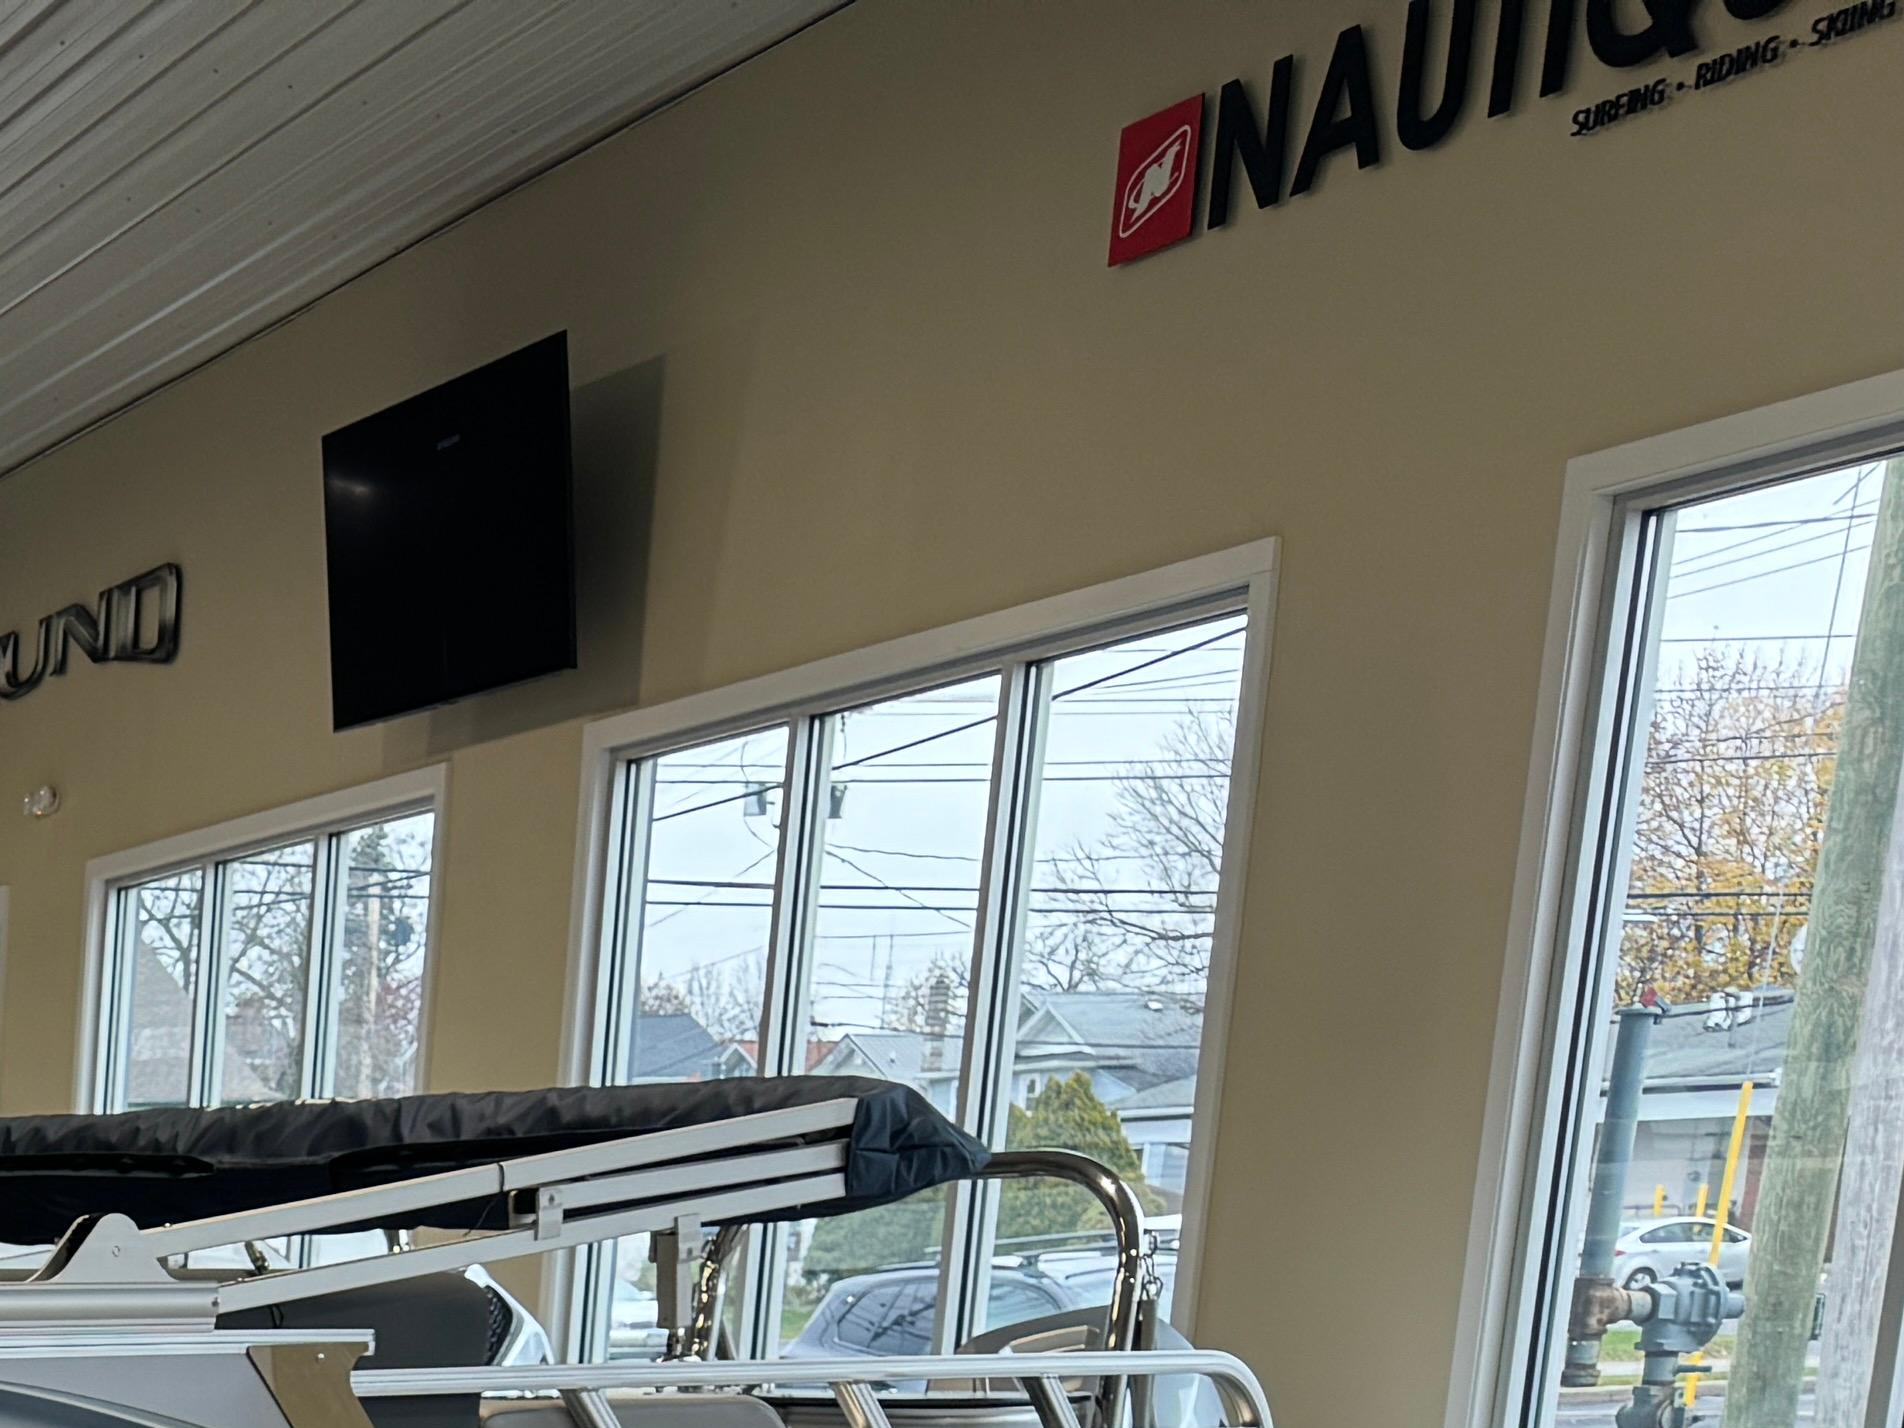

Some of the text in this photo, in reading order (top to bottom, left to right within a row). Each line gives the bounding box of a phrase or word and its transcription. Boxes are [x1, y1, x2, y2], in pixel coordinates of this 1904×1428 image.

[1207, 0, 1794, 229] NAUTI
[1570, 78, 1666, 136] SURFING
[1694, 35, 1780, 90] RIDING
